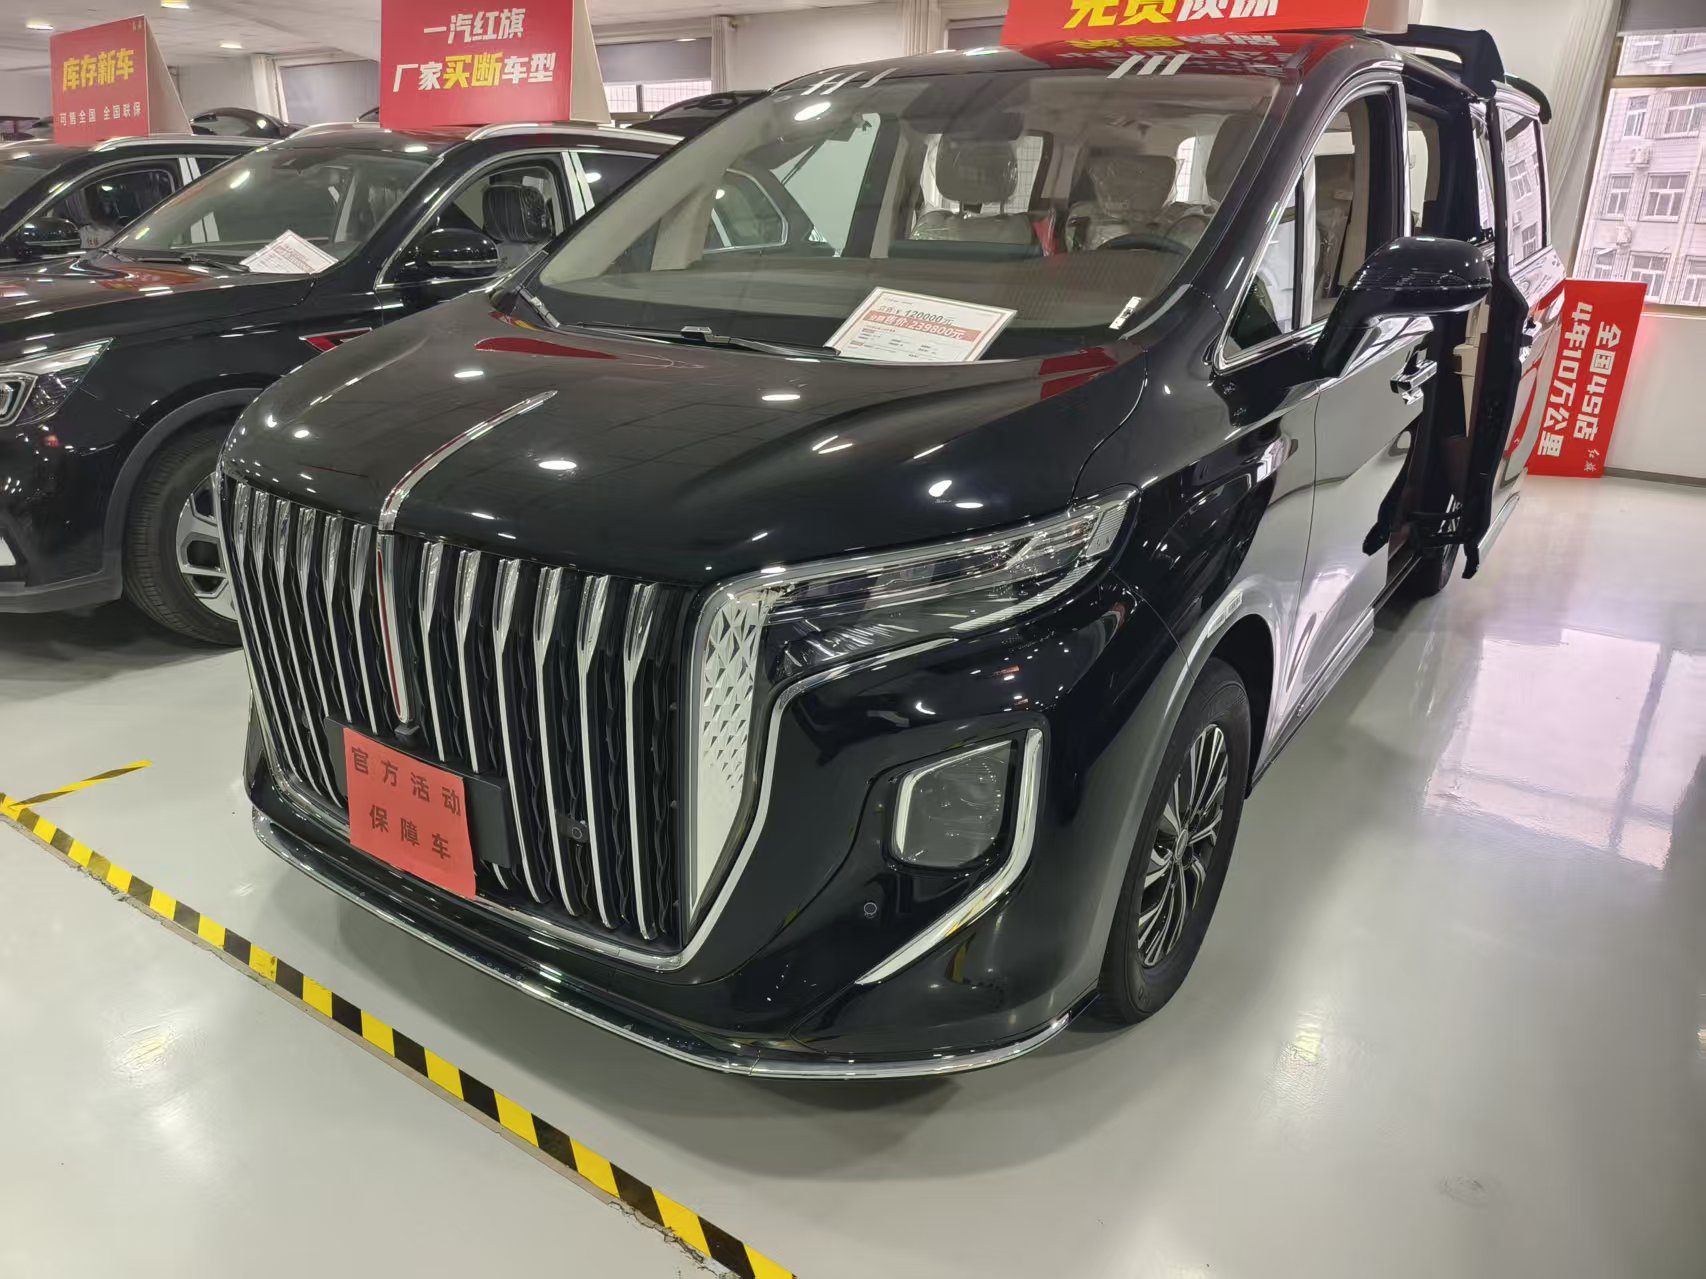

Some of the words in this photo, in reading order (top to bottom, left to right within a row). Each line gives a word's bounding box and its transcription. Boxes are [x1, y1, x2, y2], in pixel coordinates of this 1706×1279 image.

[424, 8, 526, 44] 一汽红旗
[63, 48, 134, 91] 库存新车
[393, 52, 556, 93] 厂家买断车型
[1537, 301, 1593, 458] 4年10万公里
[1573, 321, 1622, 441] 全国4S店
[351, 746, 461, 817] 官方活动
[369, 805, 451, 859] 保障车
